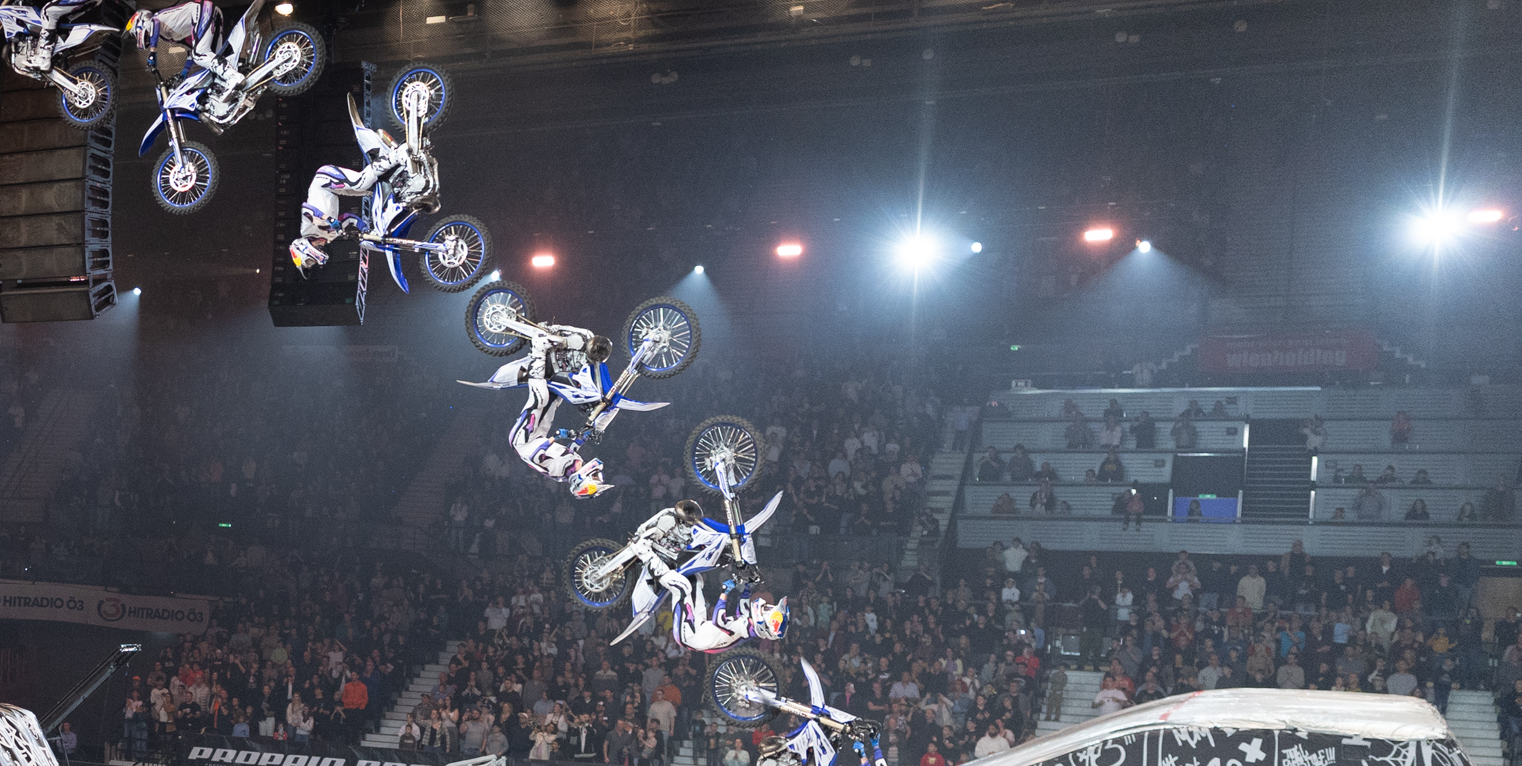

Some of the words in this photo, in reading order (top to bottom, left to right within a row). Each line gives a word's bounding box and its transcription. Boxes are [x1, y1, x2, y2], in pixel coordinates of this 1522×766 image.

[3, 595, 64, 609] HITRADIO
[65, 596, 84, 611] Ö3
[127, 607, 185, 622] HITRADIO
[187, 608, 204, 623] Ö3
[188, 746, 346, 766] PROPAIN
